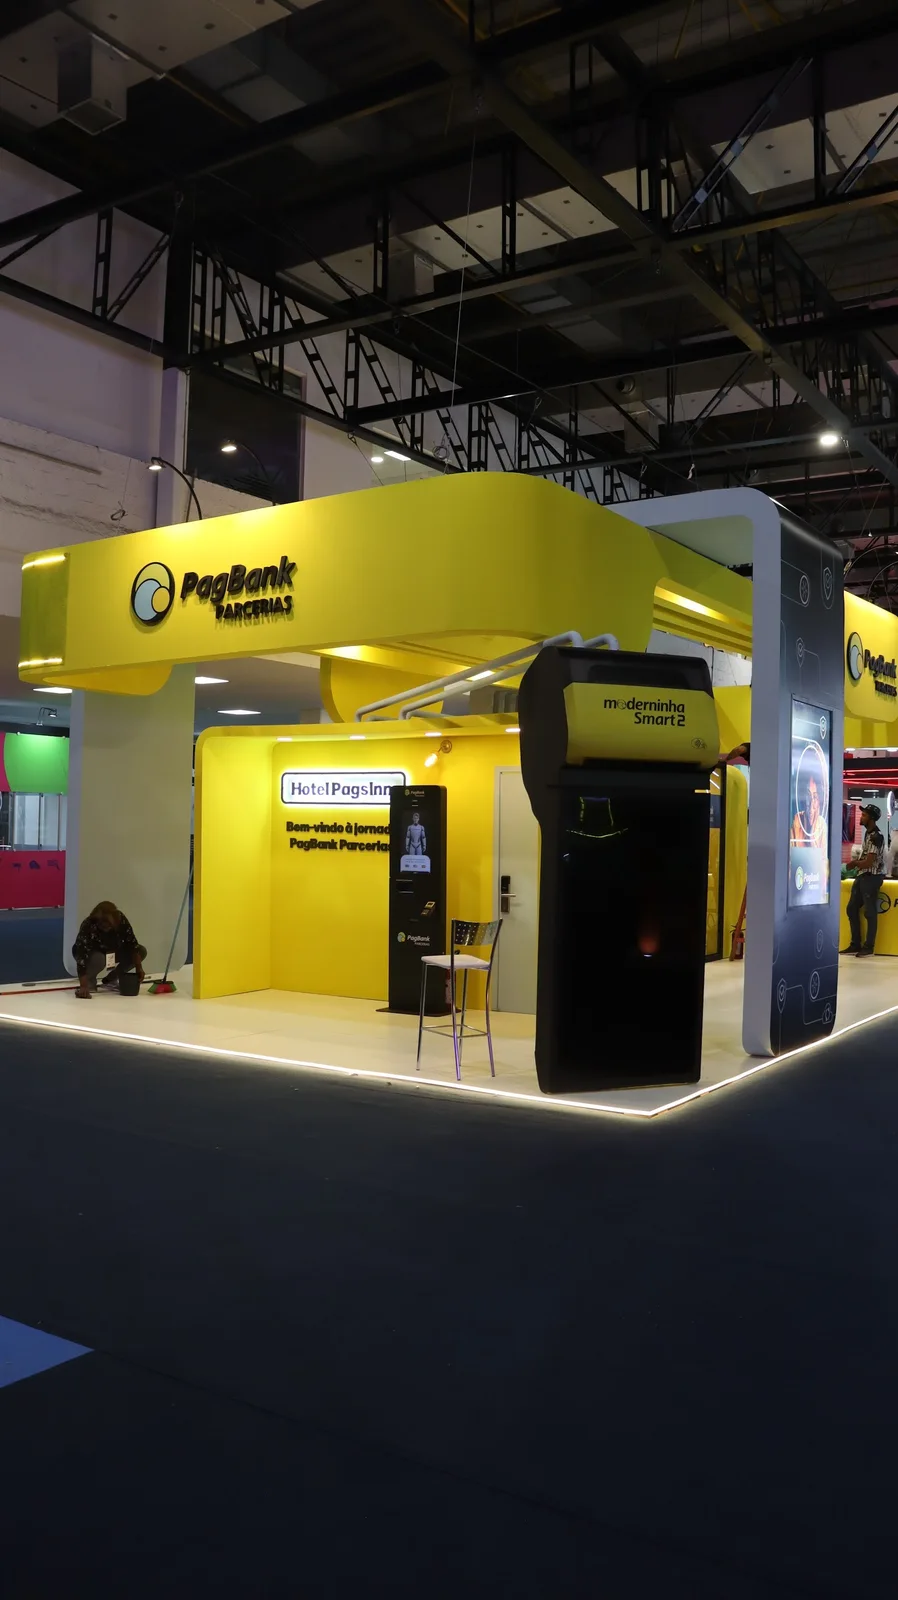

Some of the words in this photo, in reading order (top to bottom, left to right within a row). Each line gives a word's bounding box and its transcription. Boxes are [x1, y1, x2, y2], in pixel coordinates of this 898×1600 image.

[180, 555, 296, 603] PagBank
[215, 595, 293, 620] PARCERIAS
[864, 649, 897, 678] PagBank
[604, 697, 685, 713] moderninha
[634, 712, 675, 726] Smart
[677, 714, 685, 726] 2
[291, 782, 329, 795] Hotel
[286, 821, 344, 833] Bem-vindo
[345, 822, 353, 833] à
[354, 823, 391, 836] jornad
[290, 838, 338, 851] PagBank
